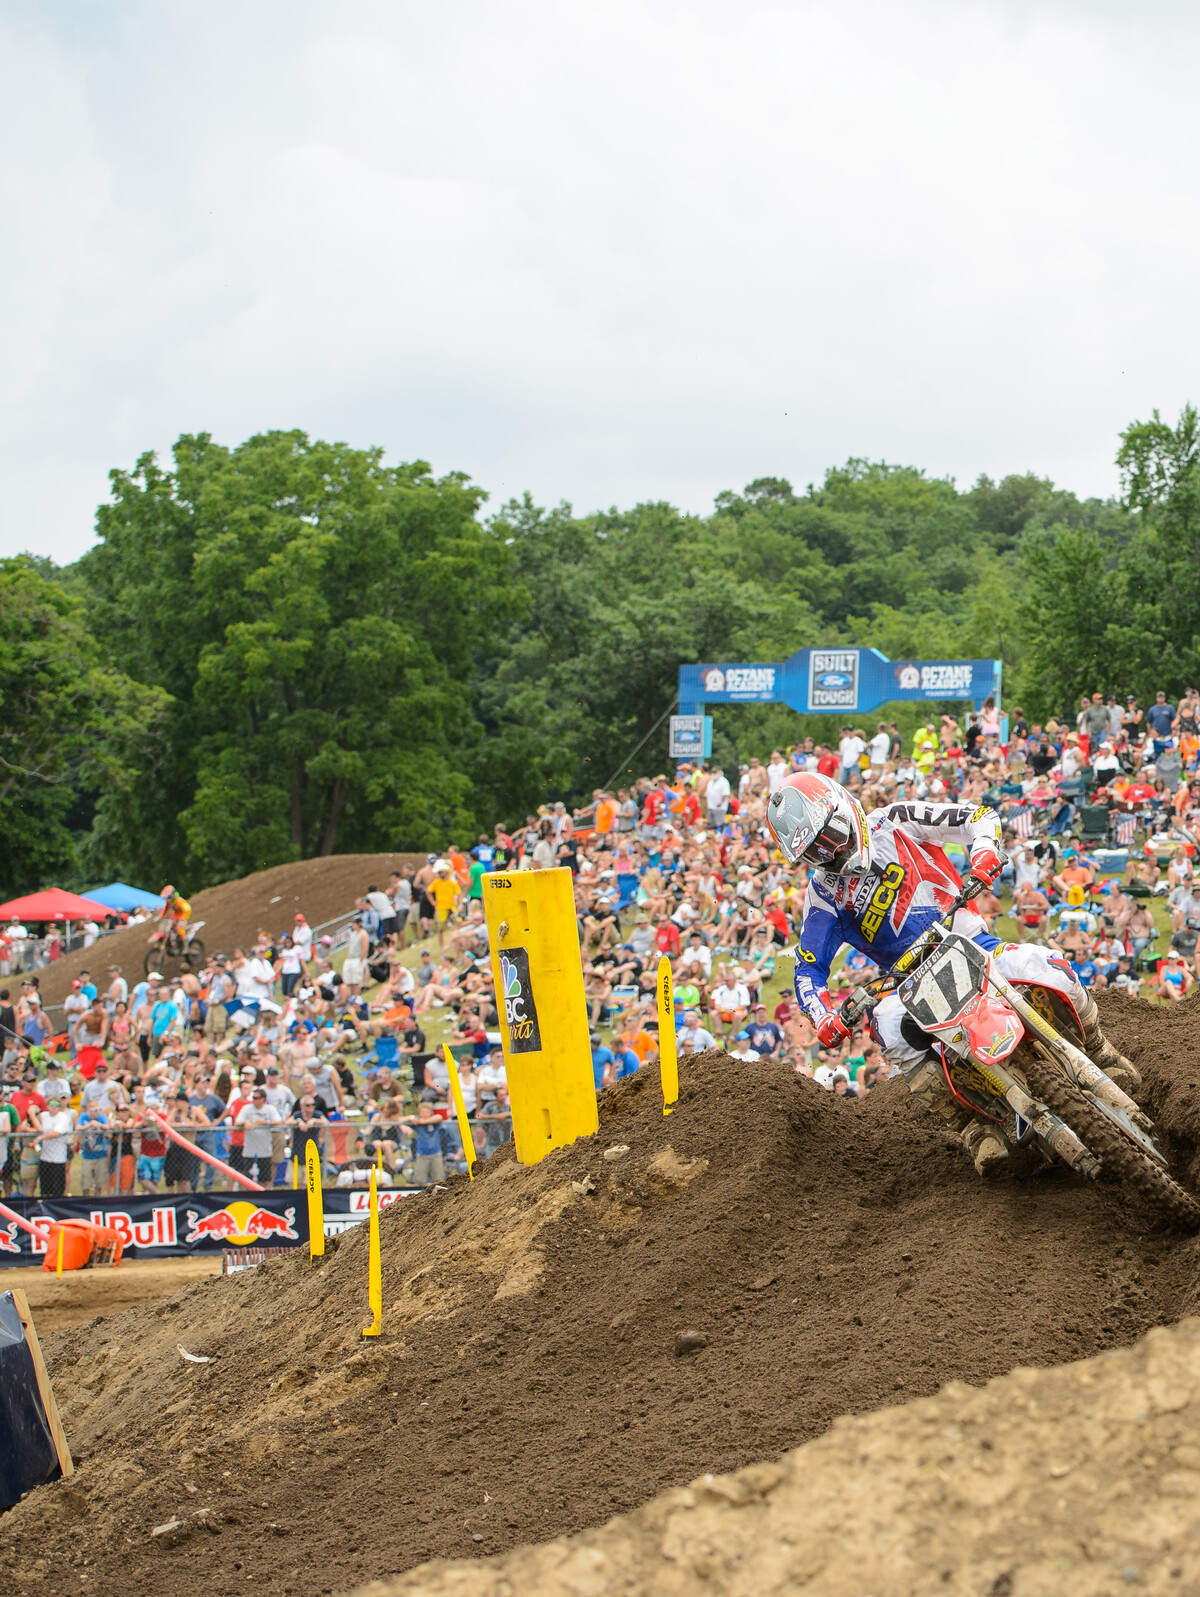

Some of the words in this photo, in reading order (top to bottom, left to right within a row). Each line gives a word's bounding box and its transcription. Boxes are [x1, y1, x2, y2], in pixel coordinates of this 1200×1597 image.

[814, 655, 855, 672] BUILT
[922, 666, 973, 679] OCTANE
[726, 668, 775, 682] OCTANE
[822, 675, 845, 687] Ford
[813, 690, 854, 705] TOUGH
[860, 862, 906, 943] GEICO
[911, 939, 973, 1024] 17
[913, 960, 933, 983] LUCAS
[504, 997, 528, 1024] BC
[107, 1208, 176, 1248] Bull
